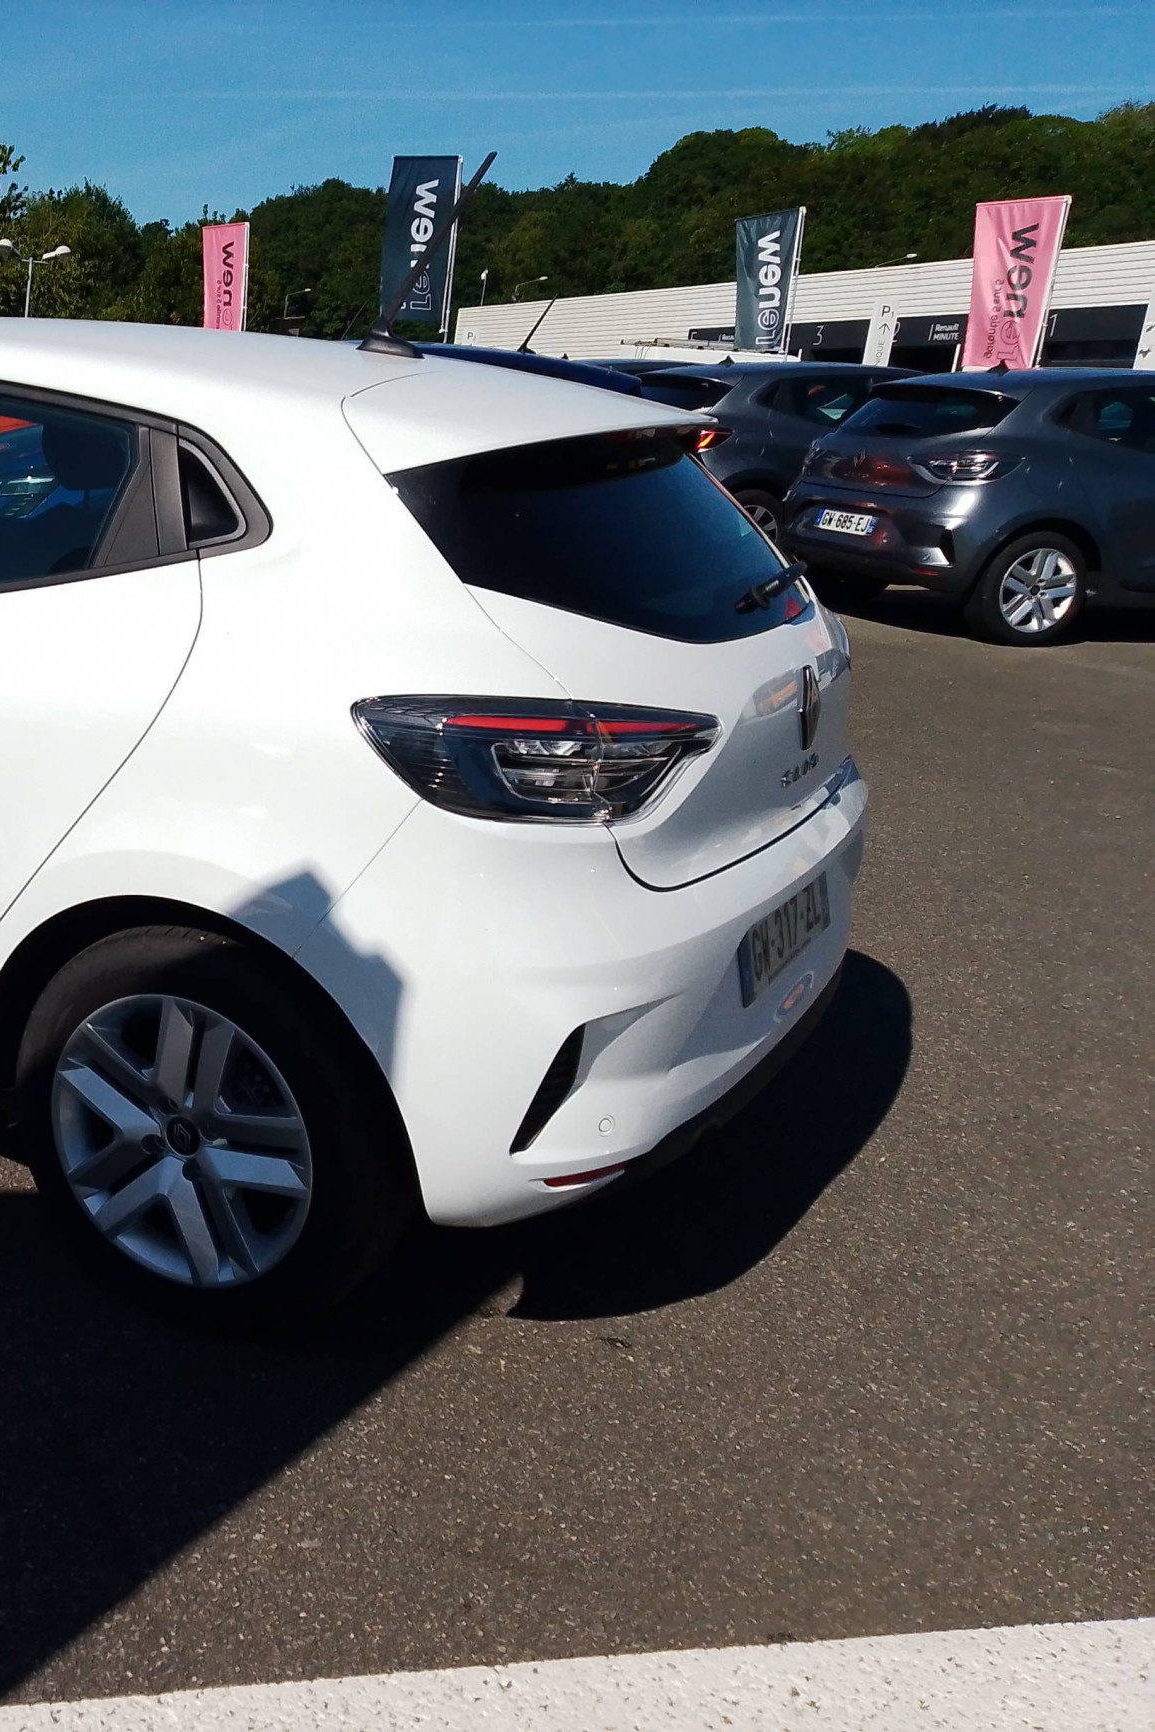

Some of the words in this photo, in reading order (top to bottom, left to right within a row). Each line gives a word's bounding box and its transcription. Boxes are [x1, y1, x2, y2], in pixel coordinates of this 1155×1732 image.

[812, 325, 825, 346] 3
[932, 332, 960, 341] MINUTE
[935, 322, 960, 332] Renault
[821, 512, 871, 533] GW-685-EJ
[751, 880, 823, 982] GW-317-ZL
